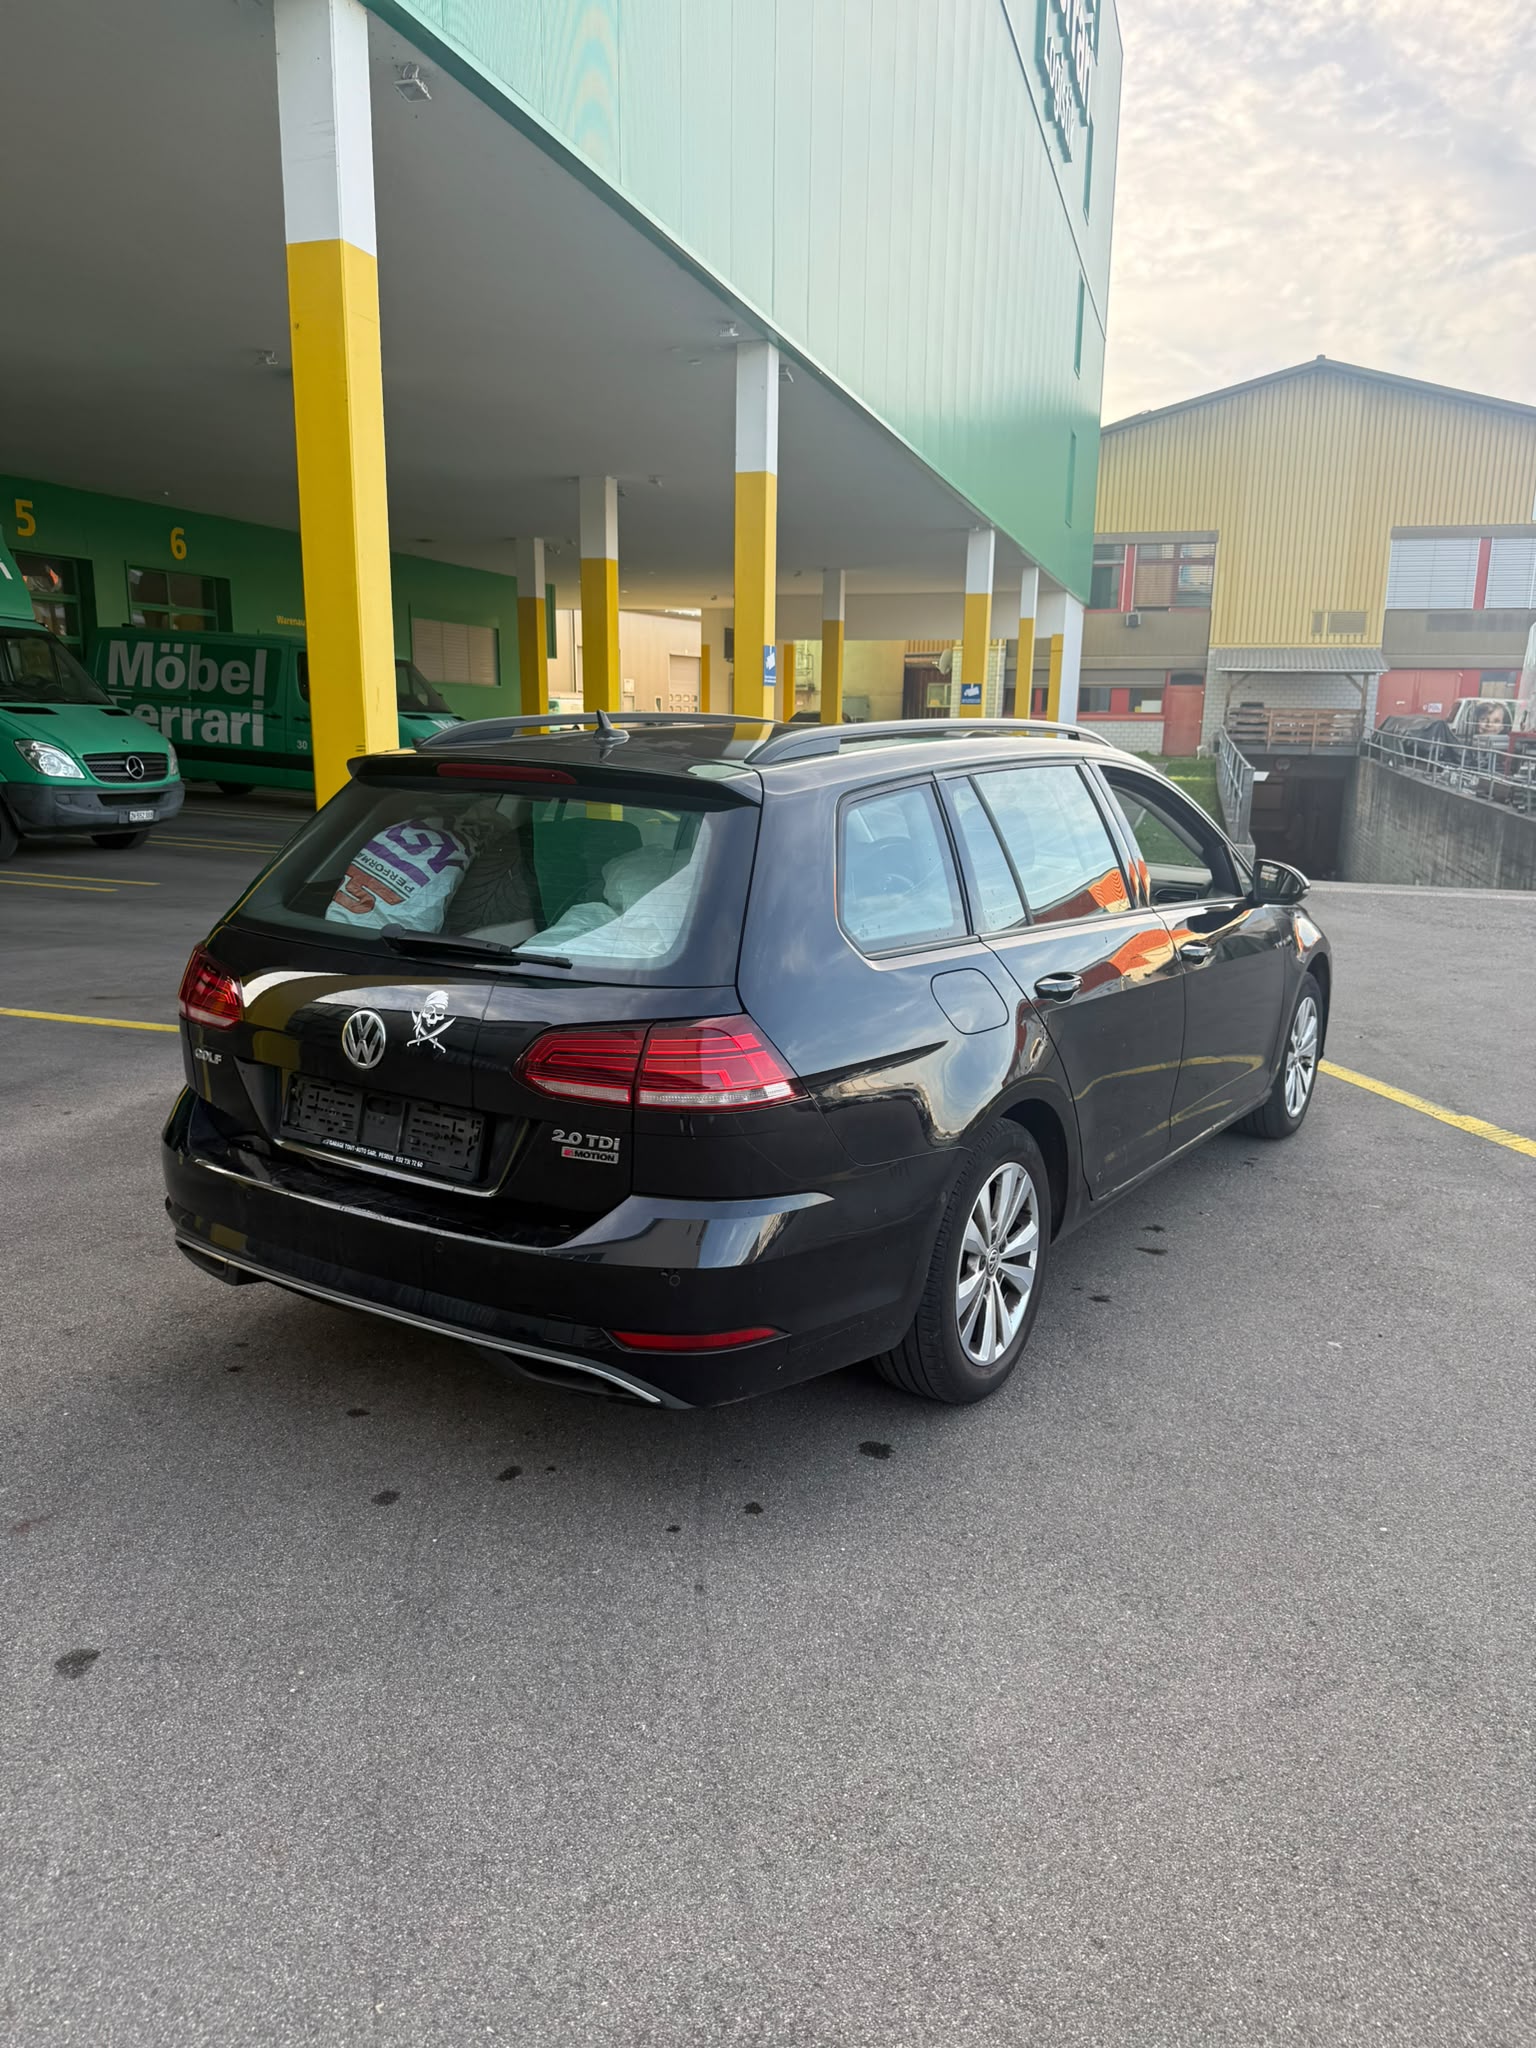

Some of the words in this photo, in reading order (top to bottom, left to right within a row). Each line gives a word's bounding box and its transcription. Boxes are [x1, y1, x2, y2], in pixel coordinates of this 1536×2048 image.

[15, 498, 37, 537] 5
[170, 527, 188, 561] 6
[107, 640, 268, 697] Möbel
[296, 739, 308, 750] 30
[195, 1048, 223, 1065] GOLF
